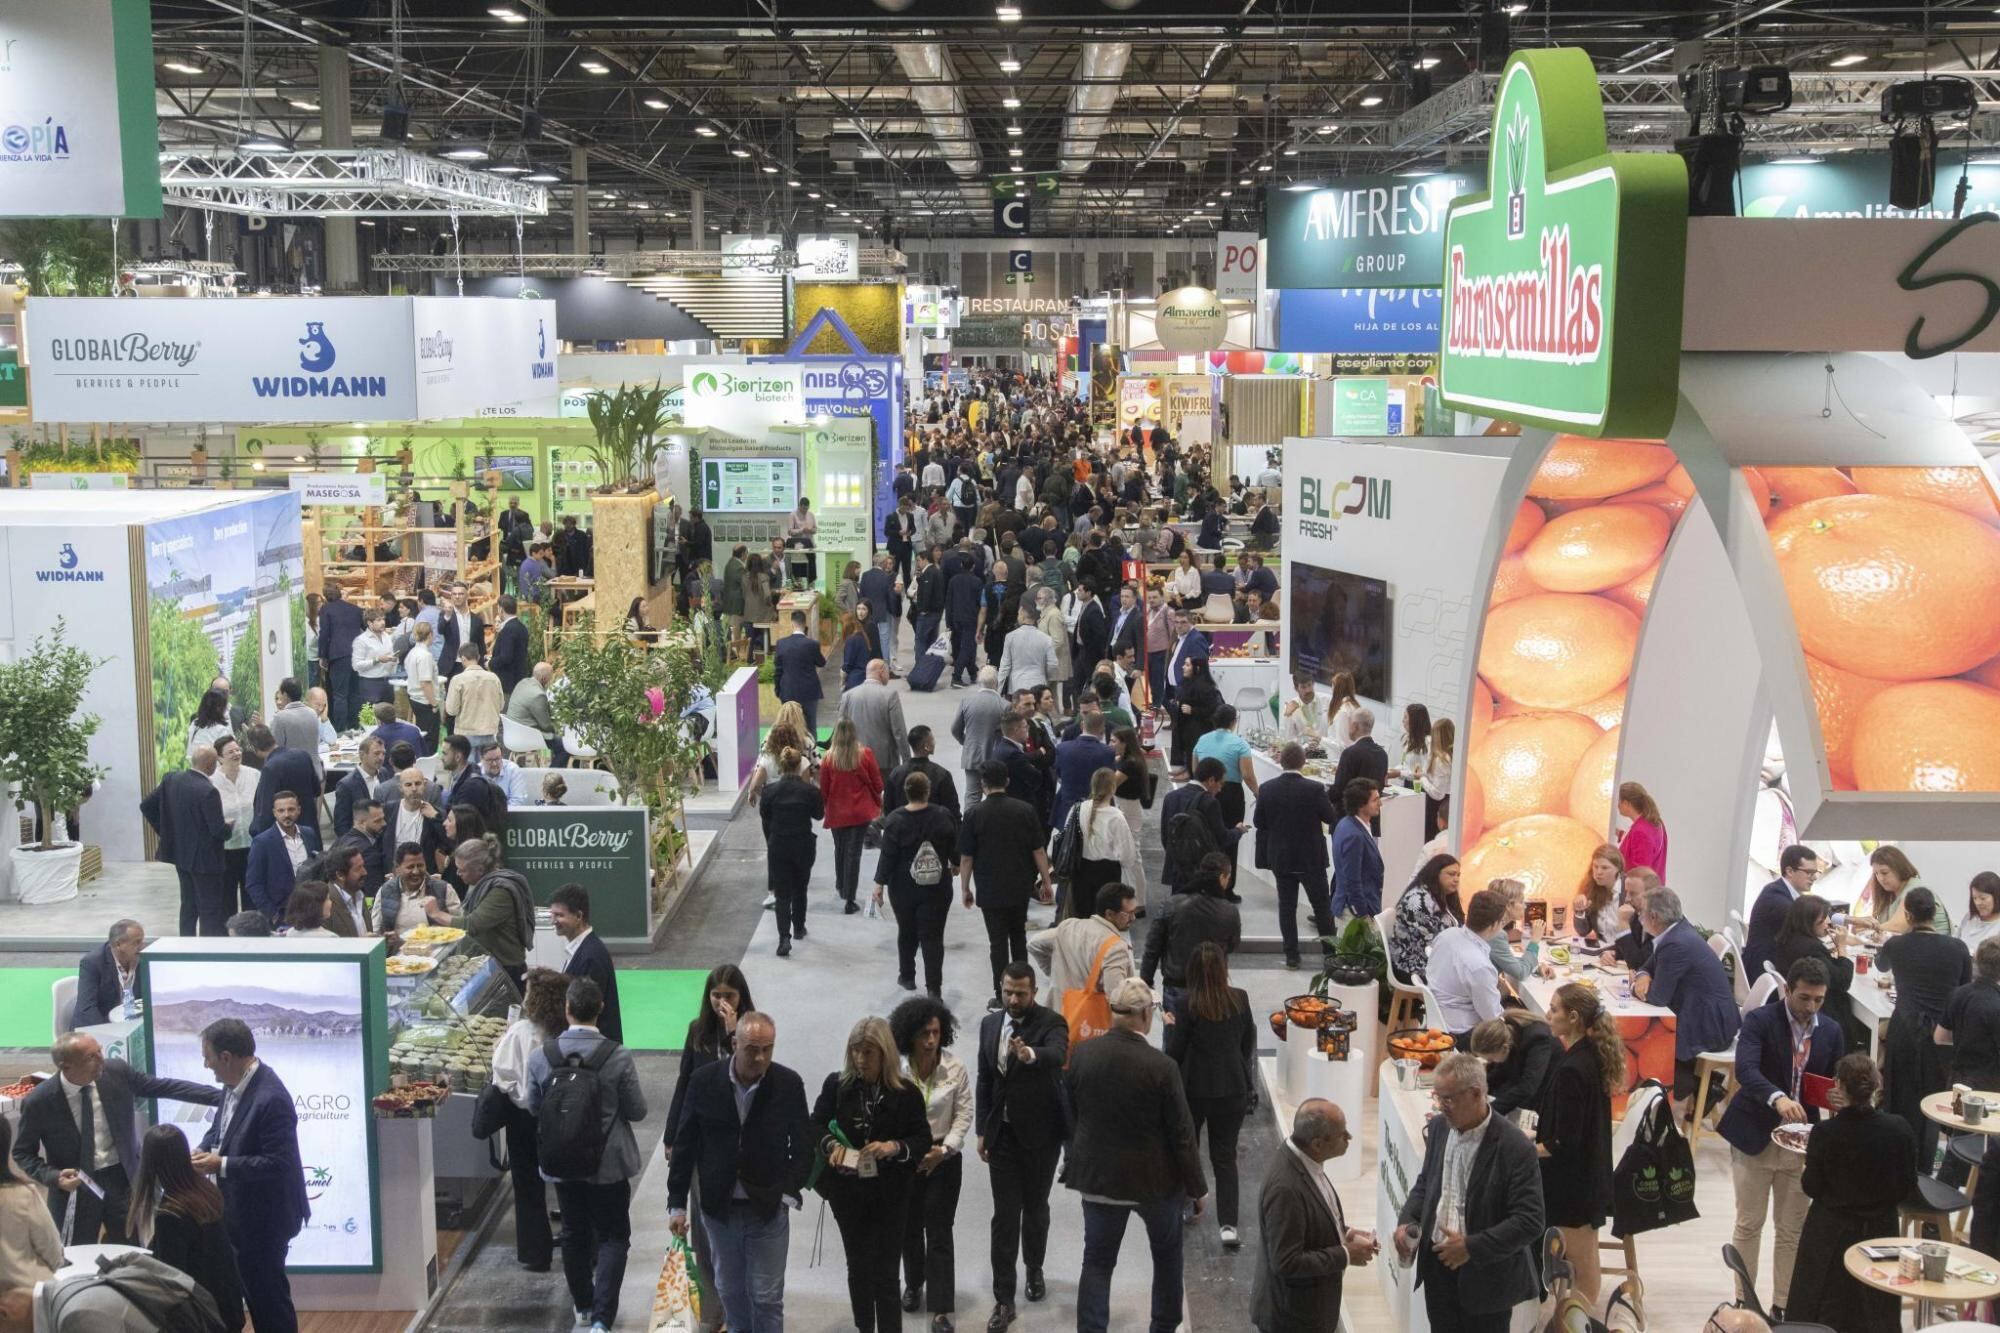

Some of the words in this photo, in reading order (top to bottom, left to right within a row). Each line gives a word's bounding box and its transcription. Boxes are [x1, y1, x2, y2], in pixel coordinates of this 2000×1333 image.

[34, 153, 53, 162] VIDA
[1002, 201, 1025, 229] C
[1014, 253, 1028, 270] C
[1355, 253, 1407, 274] GROUP
[1447, 225, 1601, 361] Eurosemillas
[971, 298, 1070, 314] RESTAURAN
[1162, 305, 1222, 318] Almaverde
[1353, 322, 1379, 331] HIJA
[1383, 322, 1397, 331] DE
[1401, 322, 1422, 331] LOS
[531, 361, 554, 379] WIDMANN
[1336, 357, 1405, 370] scegliamo
[1407, 359, 1433, 368] con
[76, 378, 122, 389] BERRIES
[139, 378, 181, 389] PEOPLE
[252, 376, 387, 398] WIDMANN
[720, 372, 794, 397] Biorizon
[755, 392, 794, 402] biotech
[499, 407, 516, 415] LOS
[805, 404, 842, 414] UEVO
[306, 490, 361, 498] MASEGOSA
[1299, 519, 1333, 541] FRESH
[35, 570, 104, 582] WIDMANN
[526, 860, 564, 870] BERRIES
[579, 860, 614, 870] PEOPLE
[295, 1094, 351, 1111] AGRO
[297, 1111, 350, 1122] agriculture
